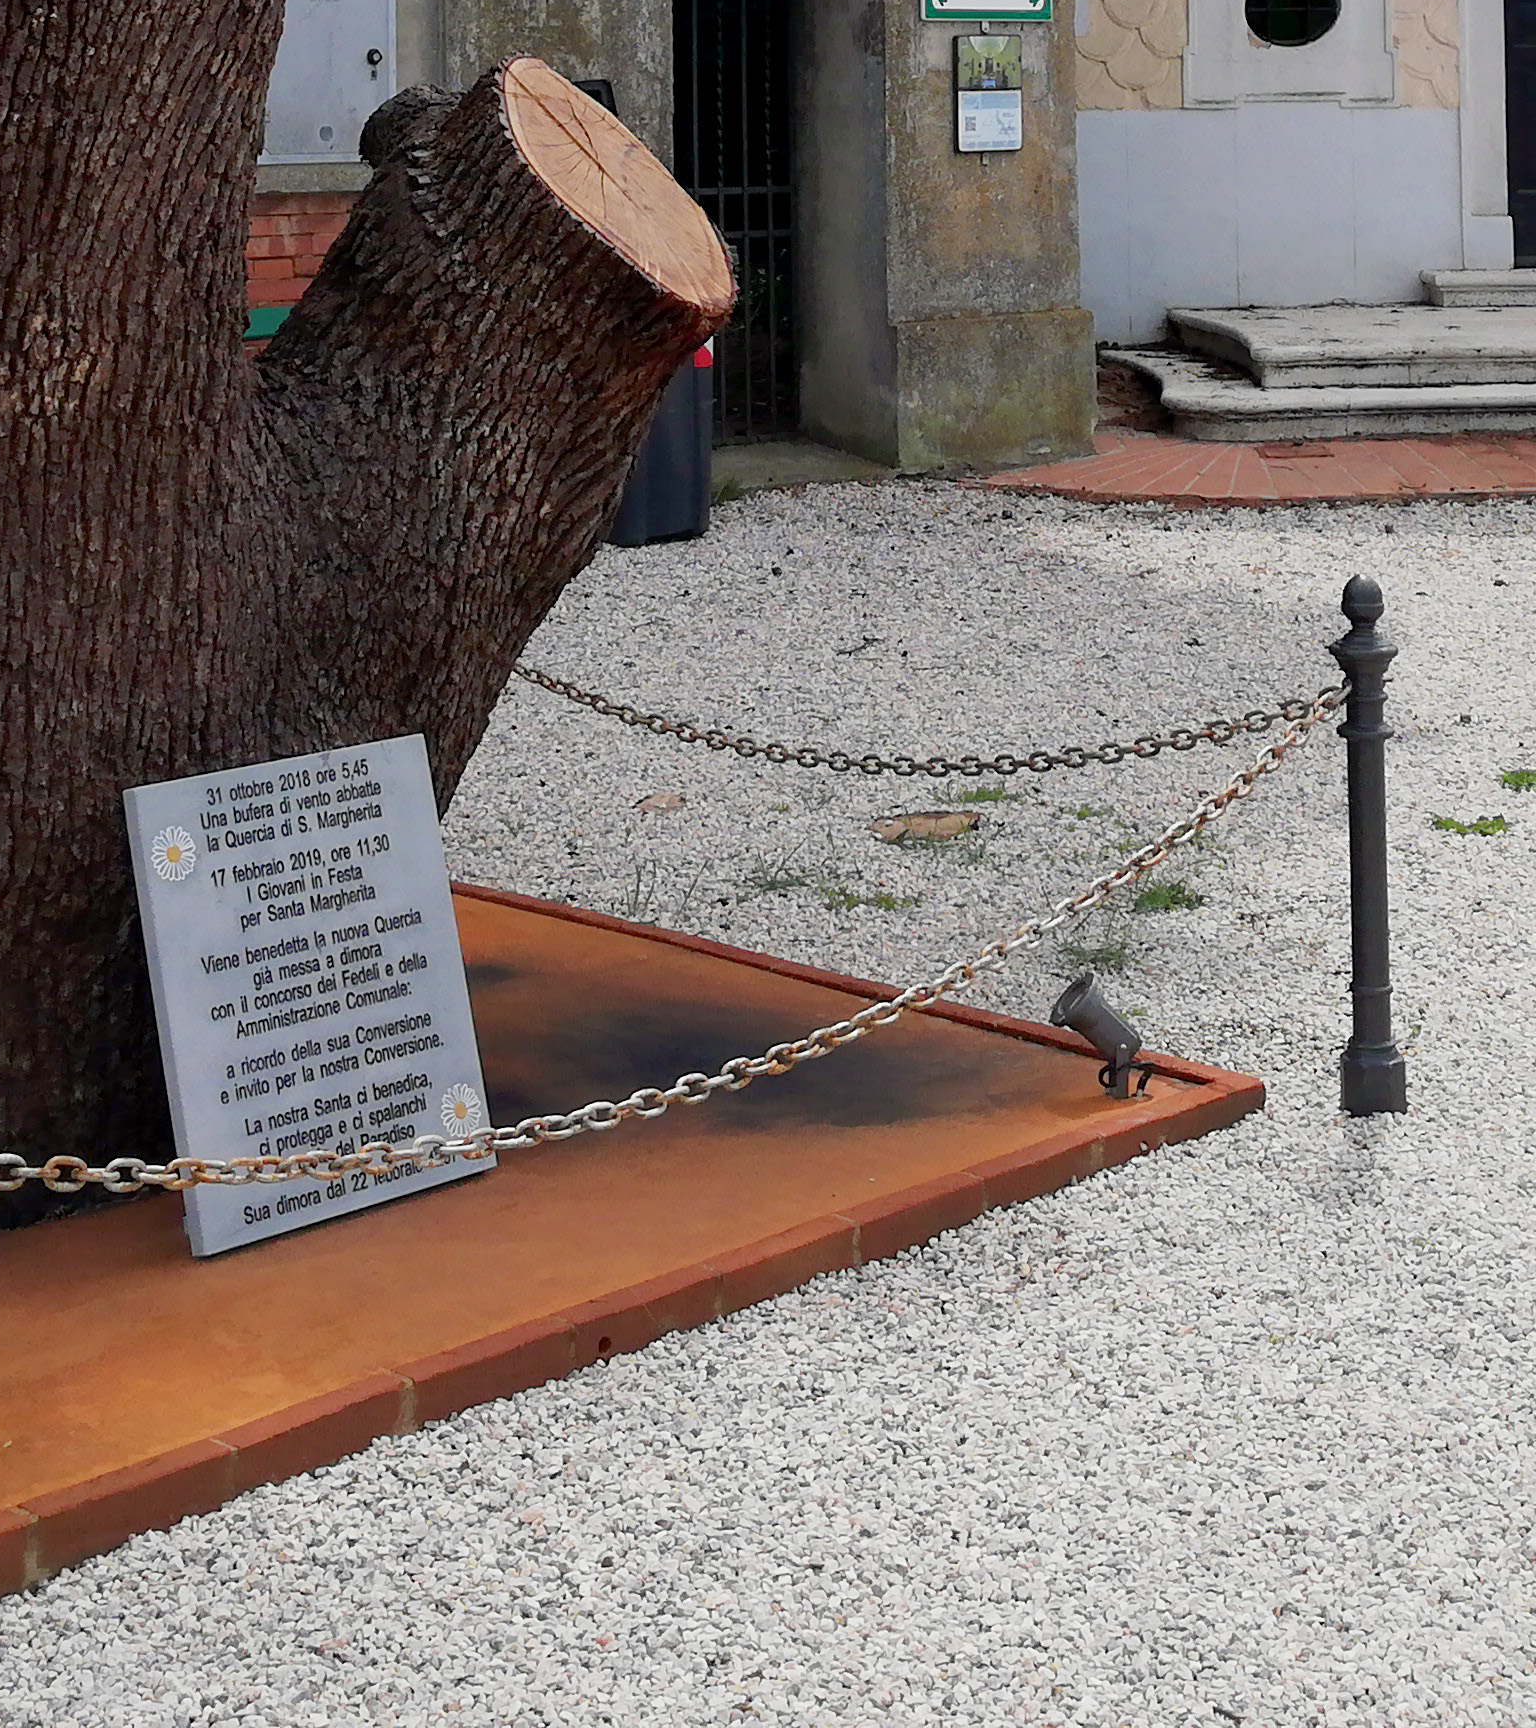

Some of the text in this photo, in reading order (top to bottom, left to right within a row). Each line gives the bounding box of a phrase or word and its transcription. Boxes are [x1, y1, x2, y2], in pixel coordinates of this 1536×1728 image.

[200, 781, 381, 829] Una bufera di vento abbatte
[207, 759, 368, 805] 31 ottobre 2018 ore 5,45
[207, 802, 382, 852] la Quercia di S. Margherita
[211, 834, 389, 886] 17 febbraio 2019, ore 11,30
[247, 865, 363, 903] I Giovani in Festa
[240, 884, 376, 933] per Santa Margherita
[201, 908, 422, 974] Viene benedetta la nuova Quercia
[254, 944, 382, 990] già messa a dimora
[211, 953, 427, 1021] con il concorso dei Fedeli e della
[237, 980, 412, 1039] Amministrazione Comunale:
[221, 1034, 444, 1104] e invito per la nostra Conversione.
[227, 1013, 431, 1079] a ricordo della sua Conversione
[245, 1073, 432, 1136] La nostra Santa ci benedica,
[259, 1093, 426, 1156] ci protegga e ci spalanchi
[336, 1137, 355, 1157] del
[244, 1205, 271, 1224] Sua
[277, 1190, 321, 1215] dimora
[327, 1178, 346, 1200] dal
[351, 1171, 368, 1192] 22
